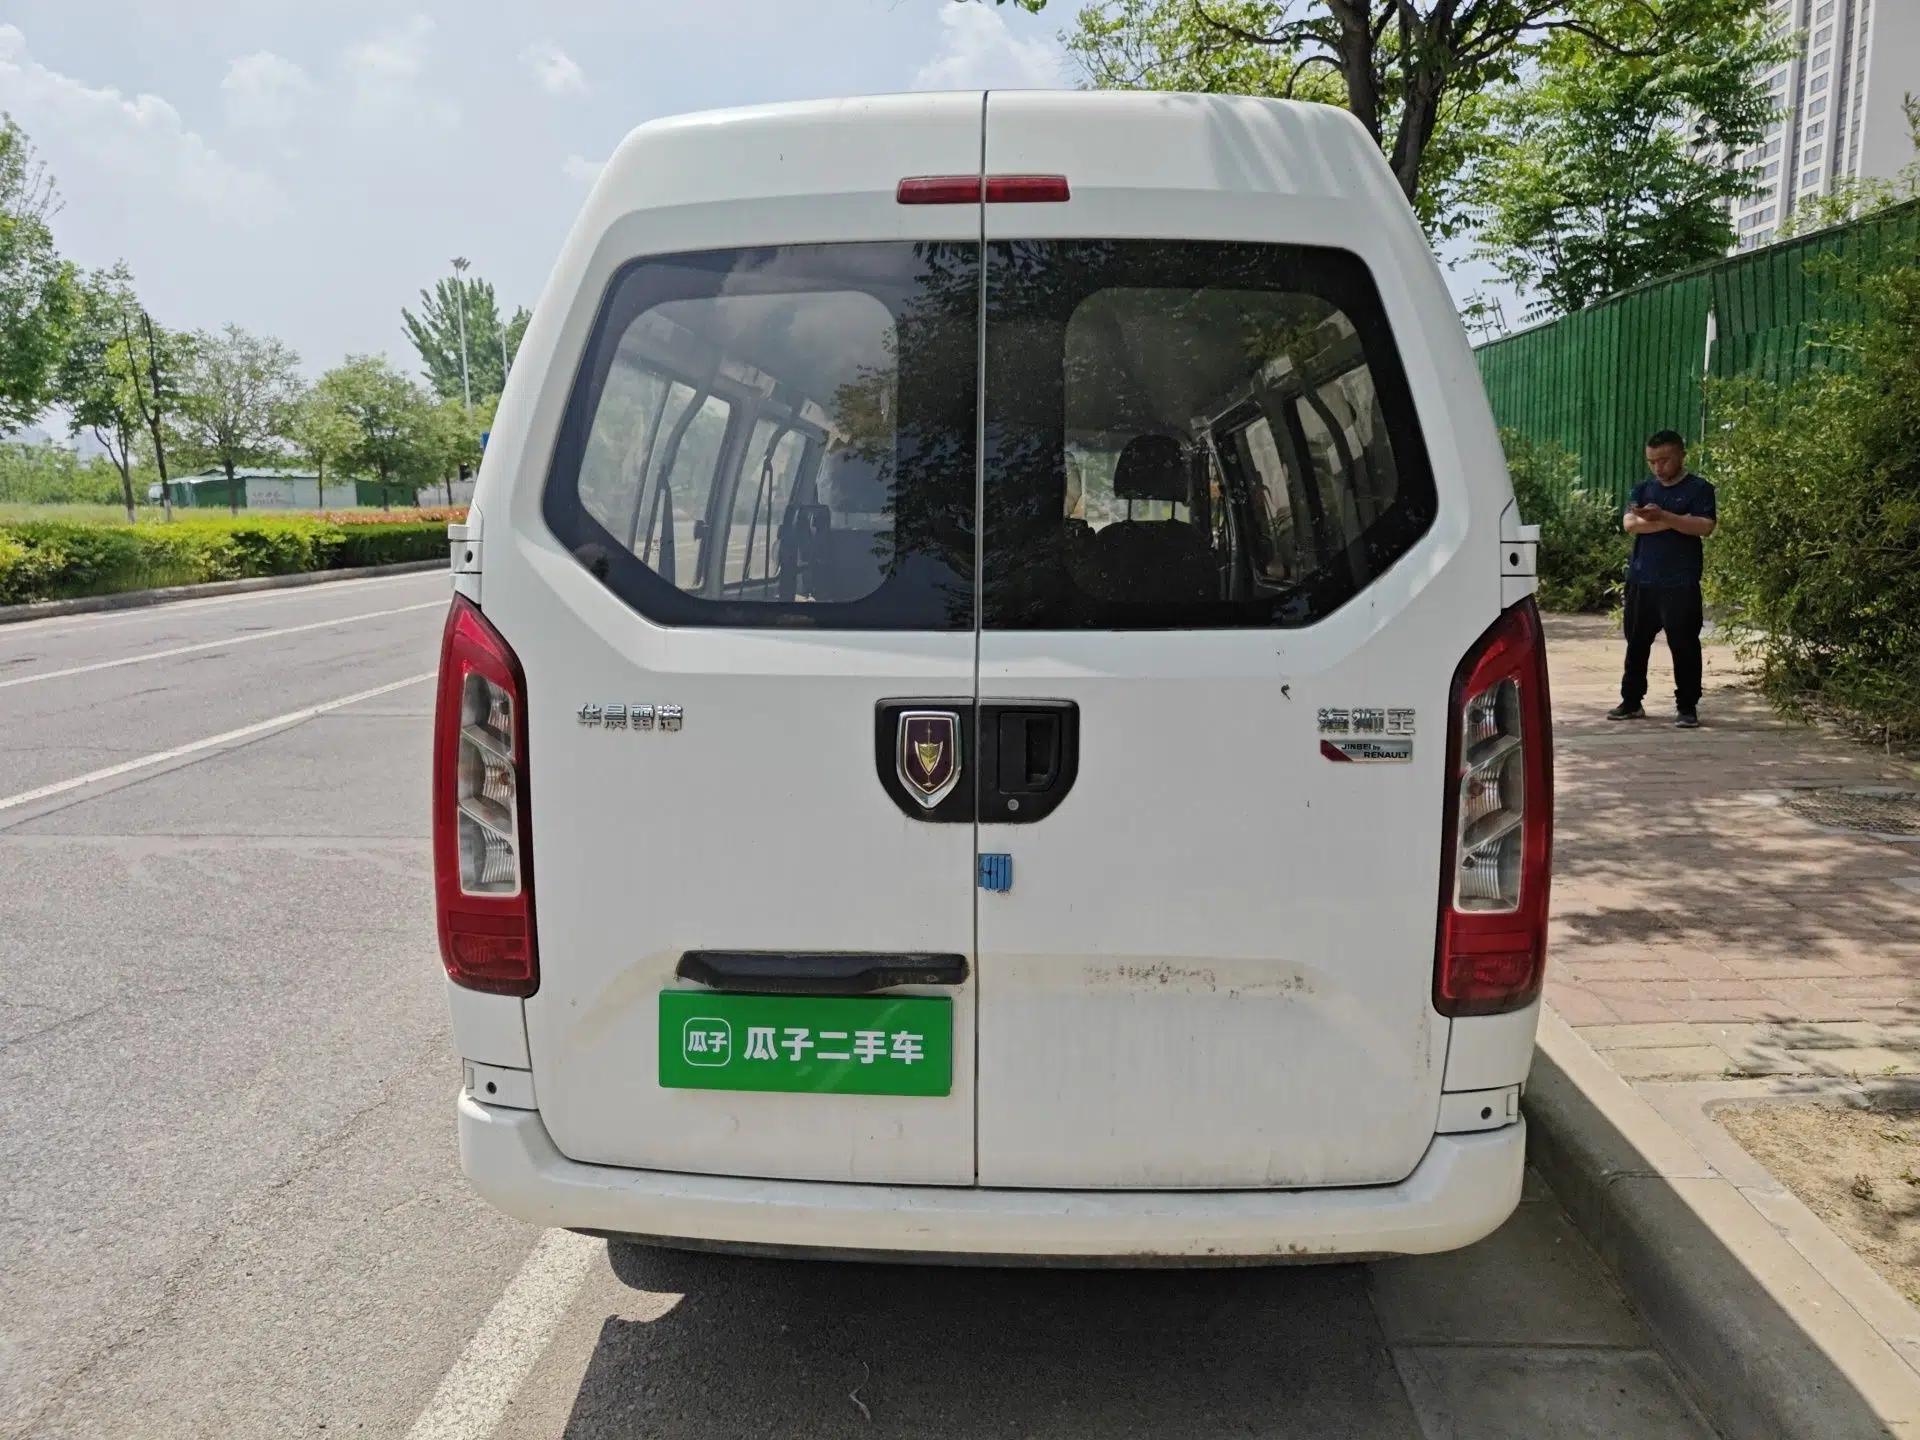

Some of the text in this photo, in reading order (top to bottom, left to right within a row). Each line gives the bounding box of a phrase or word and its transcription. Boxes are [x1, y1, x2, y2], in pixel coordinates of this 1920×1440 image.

[577, 703, 683, 732] 华晨雷诺
[1363, 751, 1409, 759] RENAULT
[688, 1031, 727, 1053] 瓜子
[743, 1026, 924, 1065] 瓜子二手车
